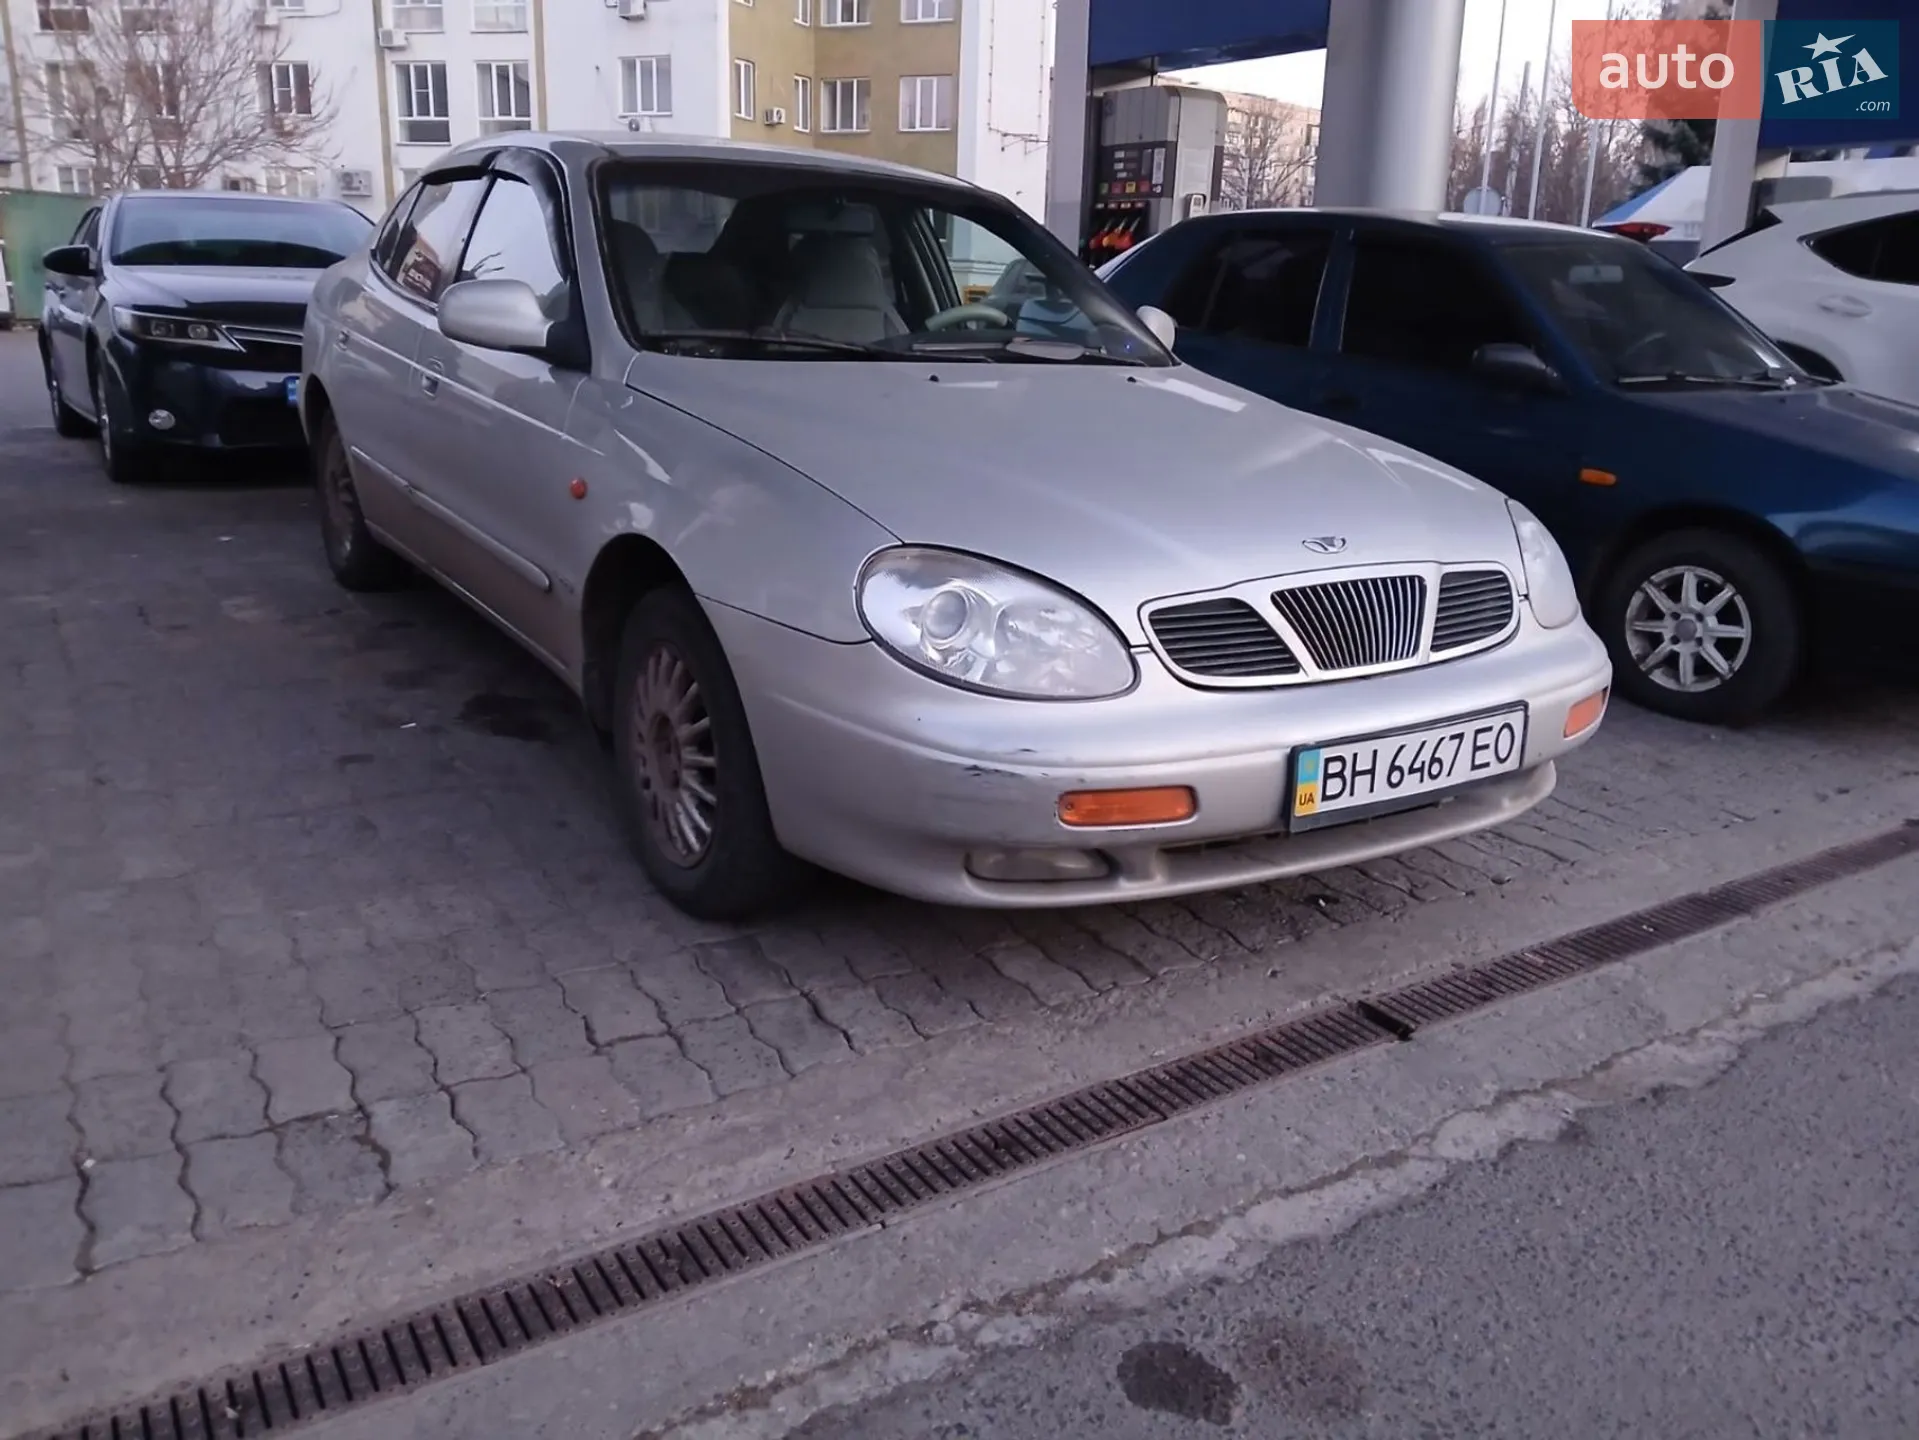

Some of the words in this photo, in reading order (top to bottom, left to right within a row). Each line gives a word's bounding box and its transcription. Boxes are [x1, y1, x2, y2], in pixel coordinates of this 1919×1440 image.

[1320, 748, 1378, 803] BH
[1386, 731, 1465, 789] 6467
[1470, 721, 1516, 772] EO
[1298, 793, 1315, 806] UA
